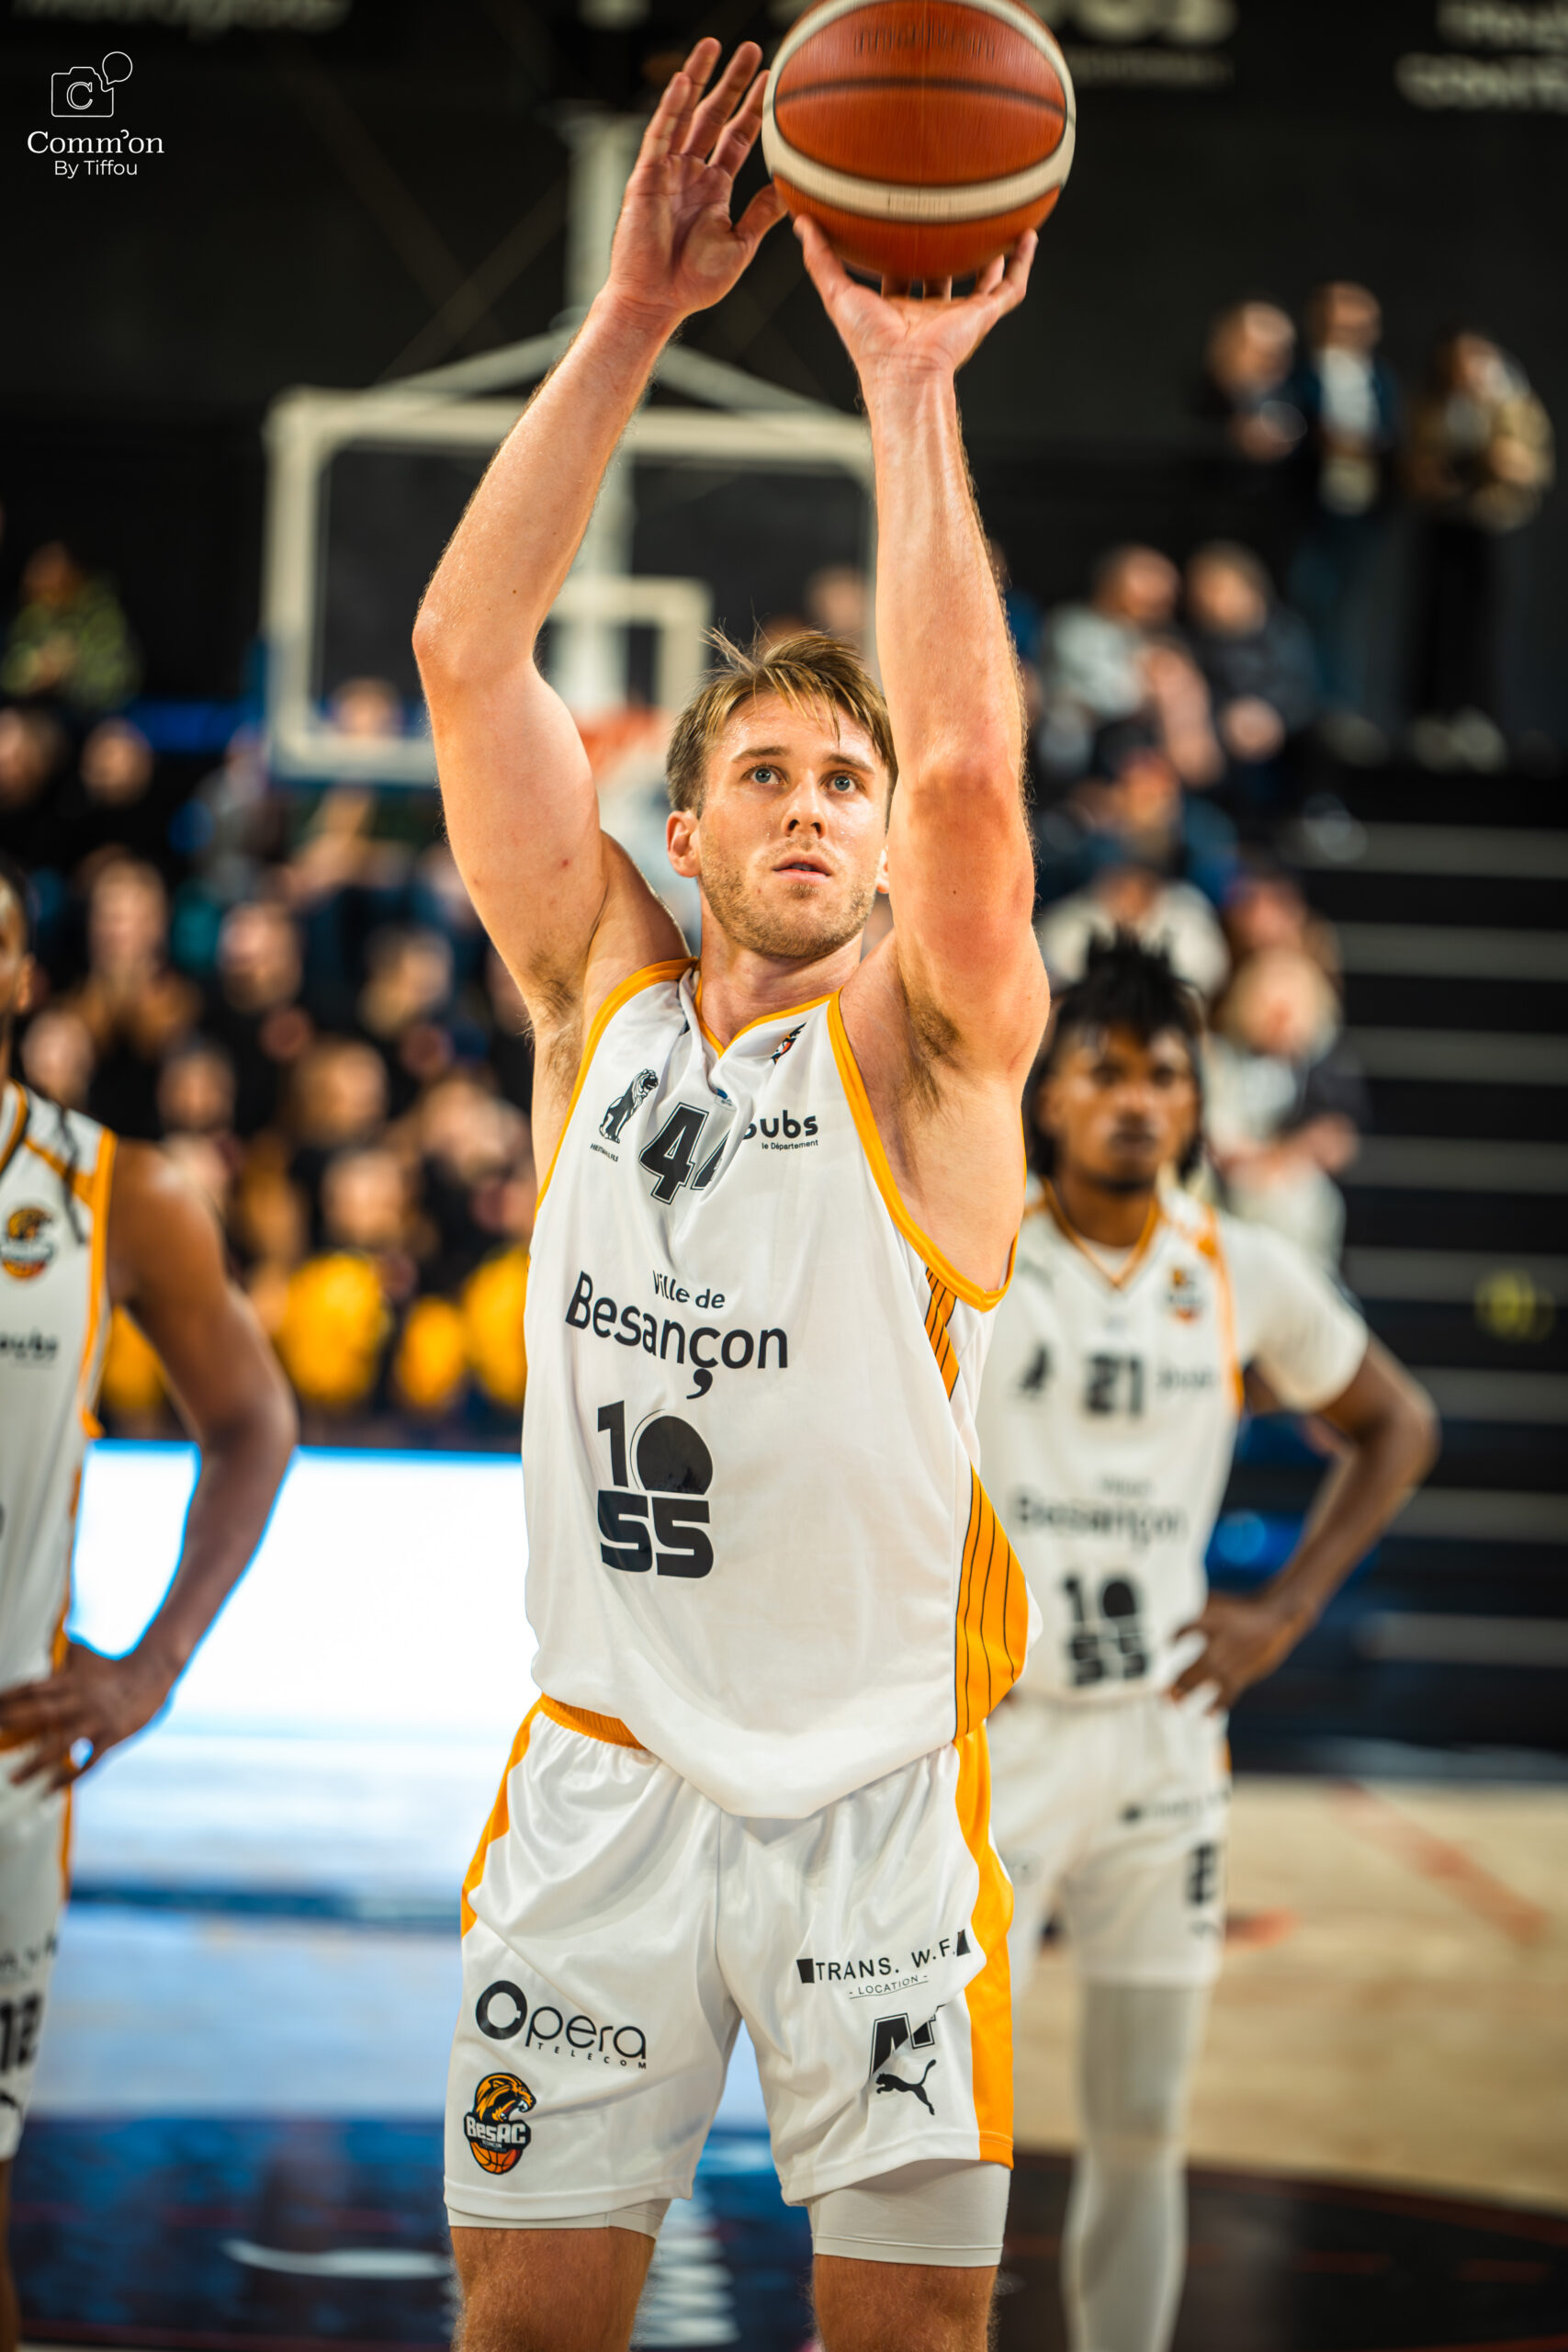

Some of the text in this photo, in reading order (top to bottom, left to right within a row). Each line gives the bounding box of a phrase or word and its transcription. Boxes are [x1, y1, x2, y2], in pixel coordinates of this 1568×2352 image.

[761, 1139, 818, 1151] le Département
[652, 1270, 726, 1309] Ville de
[565, 1270, 788, 1399] Besançon
[815, 1957, 900, 1981] TRANS.
[858, 1974, 919, 1996] LOCATION
[475, 1980, 647, 2059] Opera
[538, 2042, 647, 2069] TELECOM
[466, 2115, 526, 2144] BesAC
